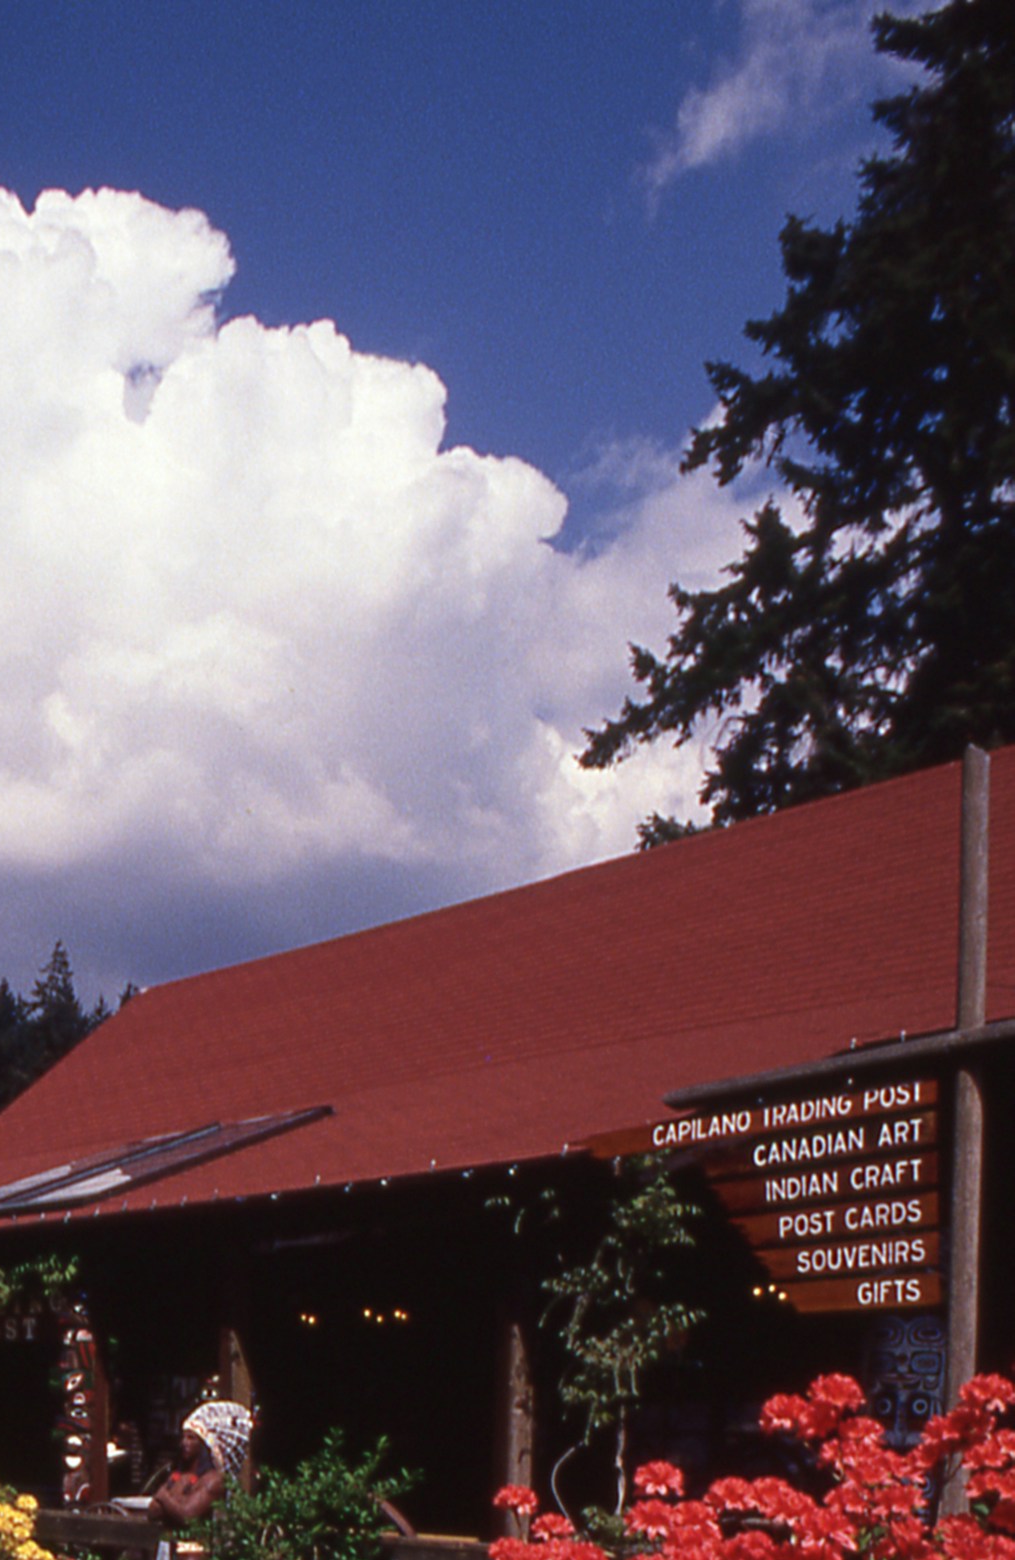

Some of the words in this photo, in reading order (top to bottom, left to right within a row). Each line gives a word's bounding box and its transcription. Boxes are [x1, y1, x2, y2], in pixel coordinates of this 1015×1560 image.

[653, 1110, 751, 1146] CAPILANO
[763, 1095, 853, 1128] TRADING
[863, 1081, 921, 1110] POST
[753, 1127, 864, 1166] CANADIAN
[878, 1118, 923, 1148] ART
[765, 1171, 838, 1202] INDIAN
[850, 1159, 922, 1190] CRAFT
[779, 1210, 835, 1239] POST
[844, 1199, 922, 1230] CARDS
[796, 1238, 926, 1273] SOUVENIRS
[857, 1279, 921, 1305] GIFTS
